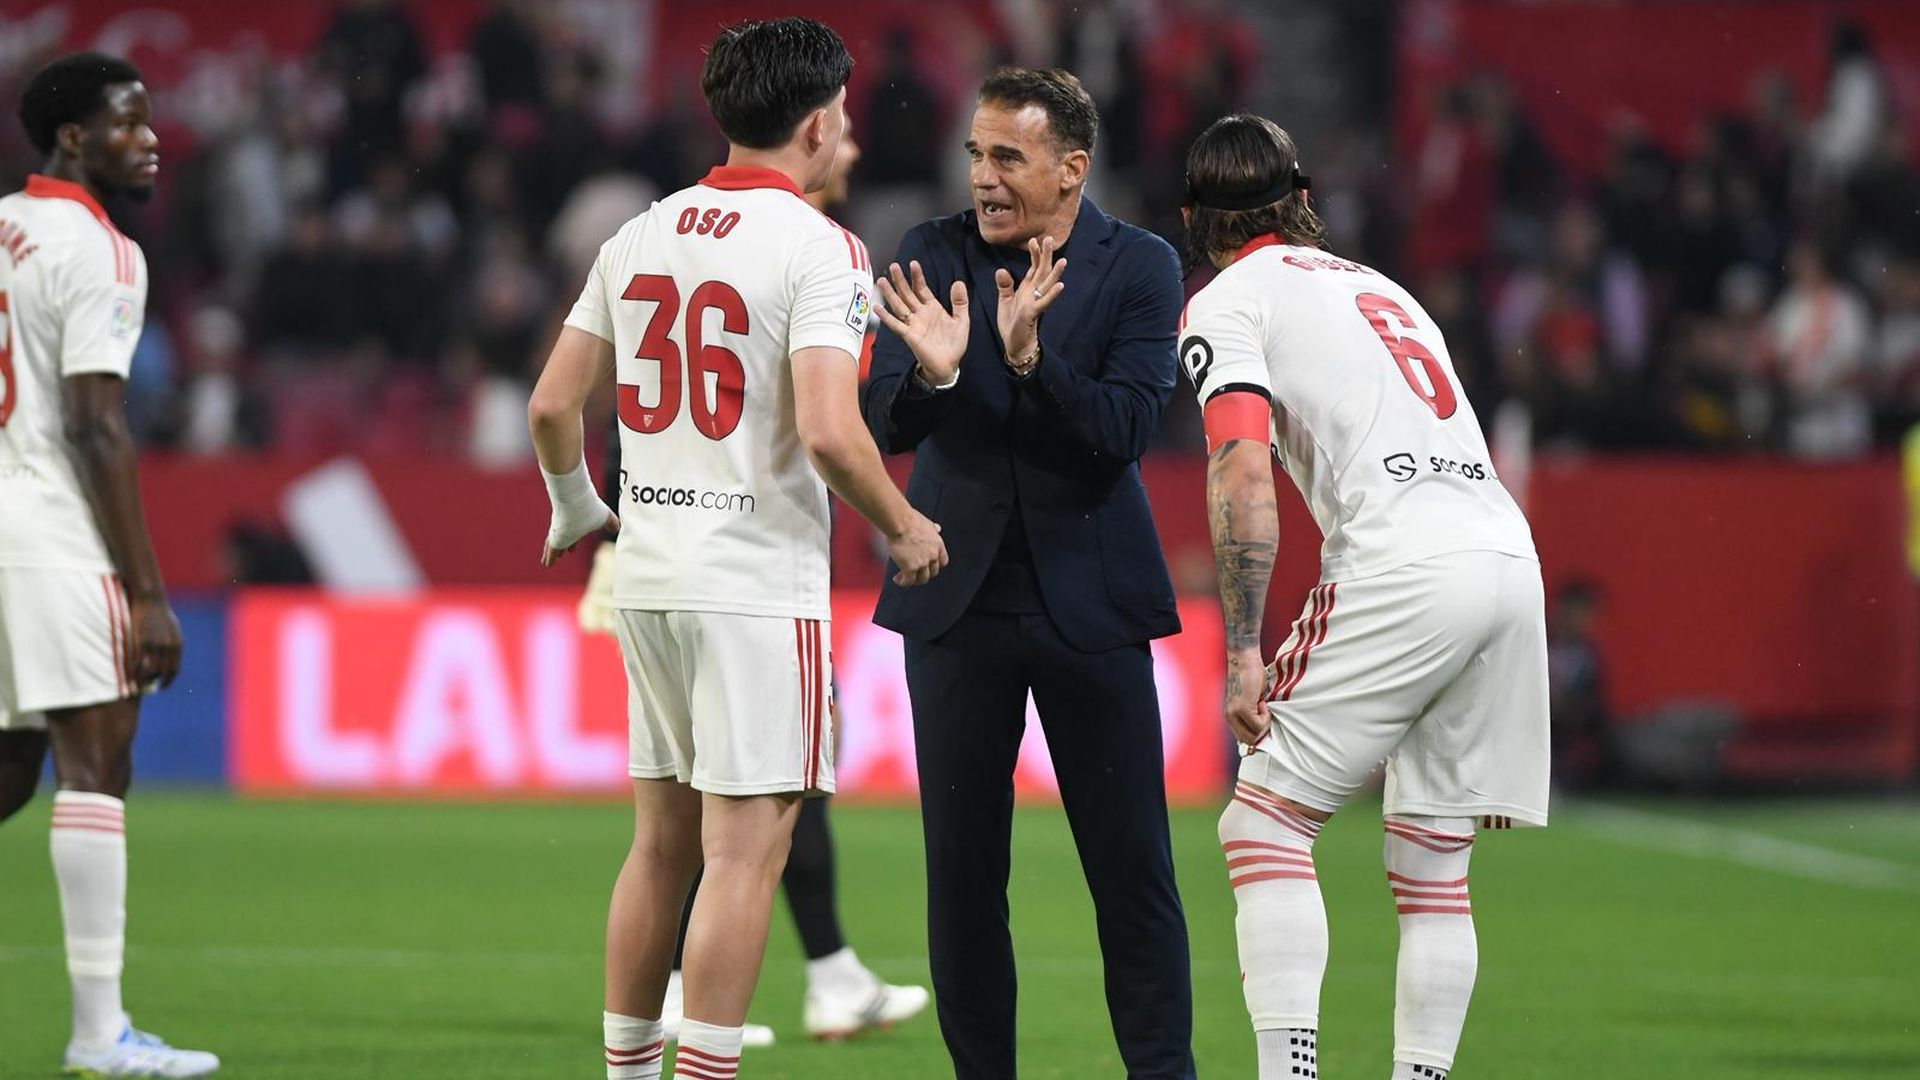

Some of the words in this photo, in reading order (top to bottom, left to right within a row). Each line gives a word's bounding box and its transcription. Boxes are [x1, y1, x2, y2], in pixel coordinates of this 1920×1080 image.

[676, 207, 741, 239] OSO
[617, 273, 749, 441] 36
[1355, 292, 1457, 420] 6
